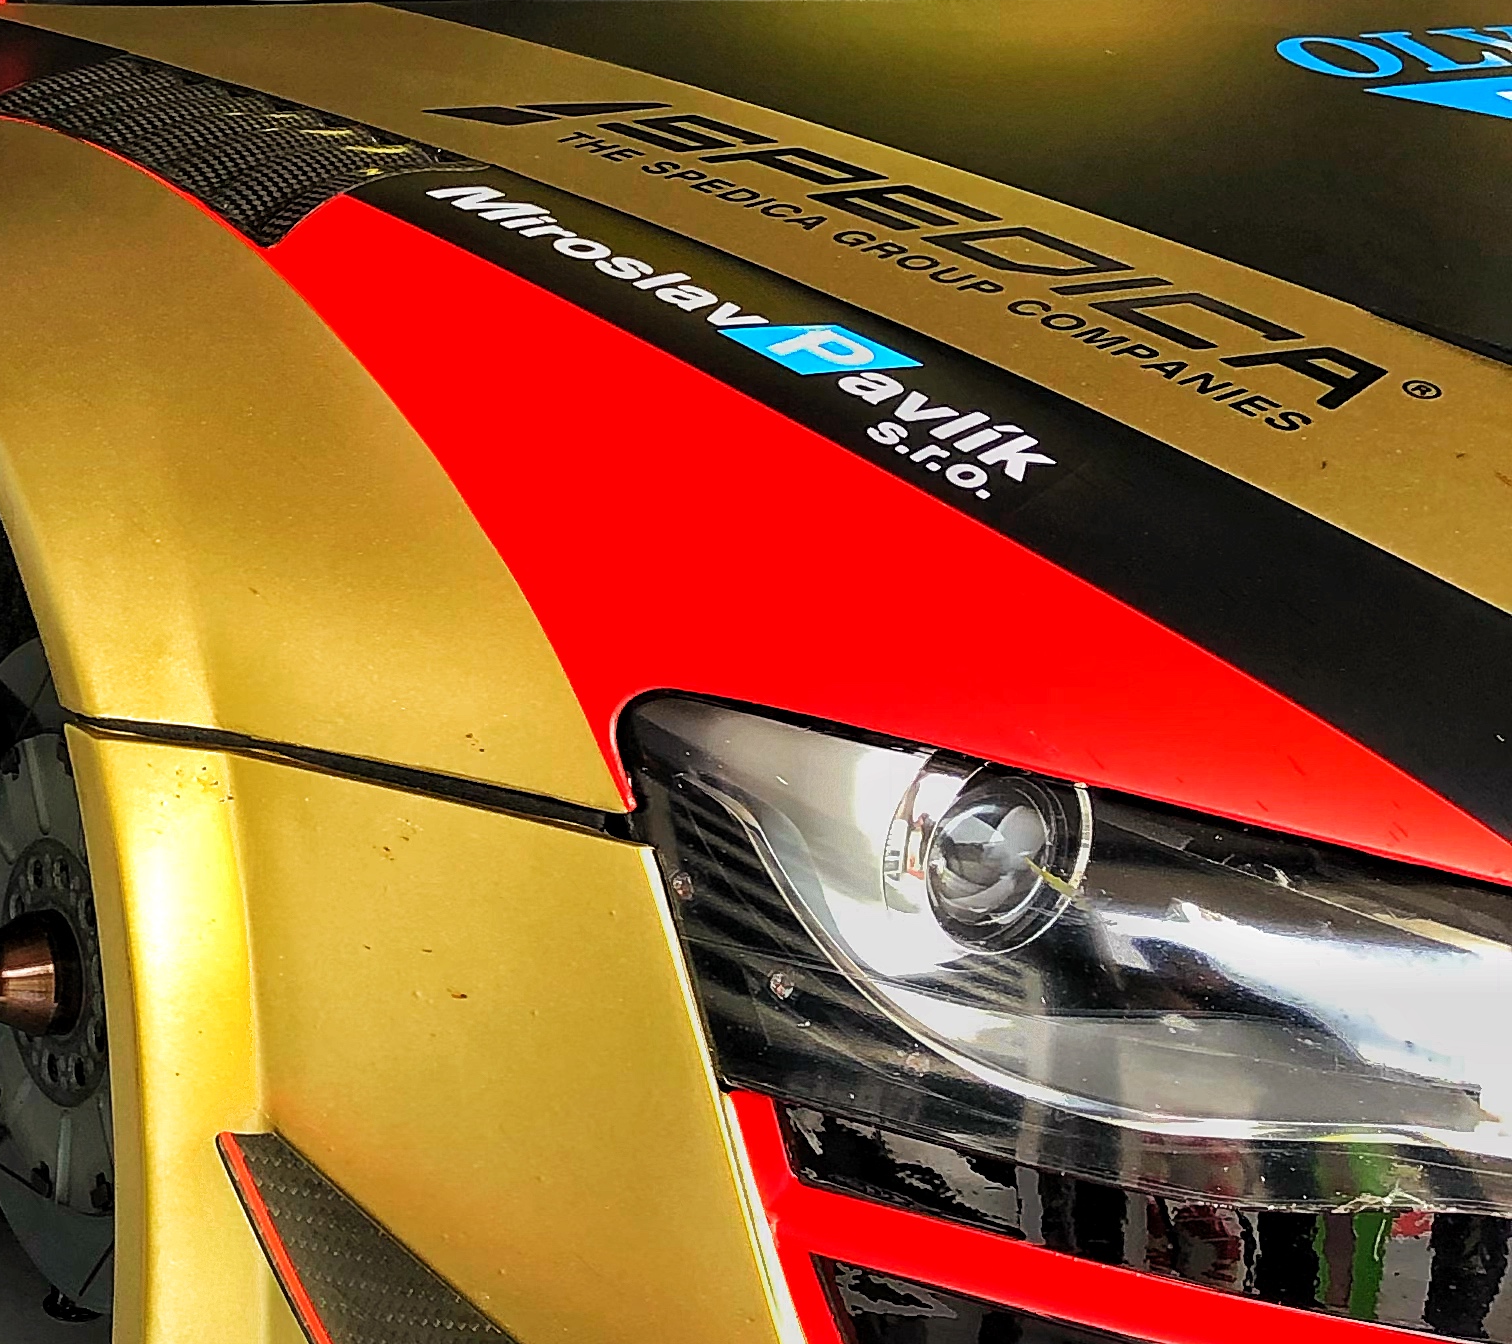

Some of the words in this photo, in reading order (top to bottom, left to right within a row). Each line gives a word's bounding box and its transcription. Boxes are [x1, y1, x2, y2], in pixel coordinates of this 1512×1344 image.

[424, 185, 771, 328] Miroslav
[766, 323, 1058, 483] Pavlík
[557, 130, 647, 163] THE
[641, 160, 829, 231] SPEDICA
[832, 229, 1004, 295] GROUP
[1006, 298, 1314, 433] COMPANIES
[865, 421, 992, 502] s.r.o.
